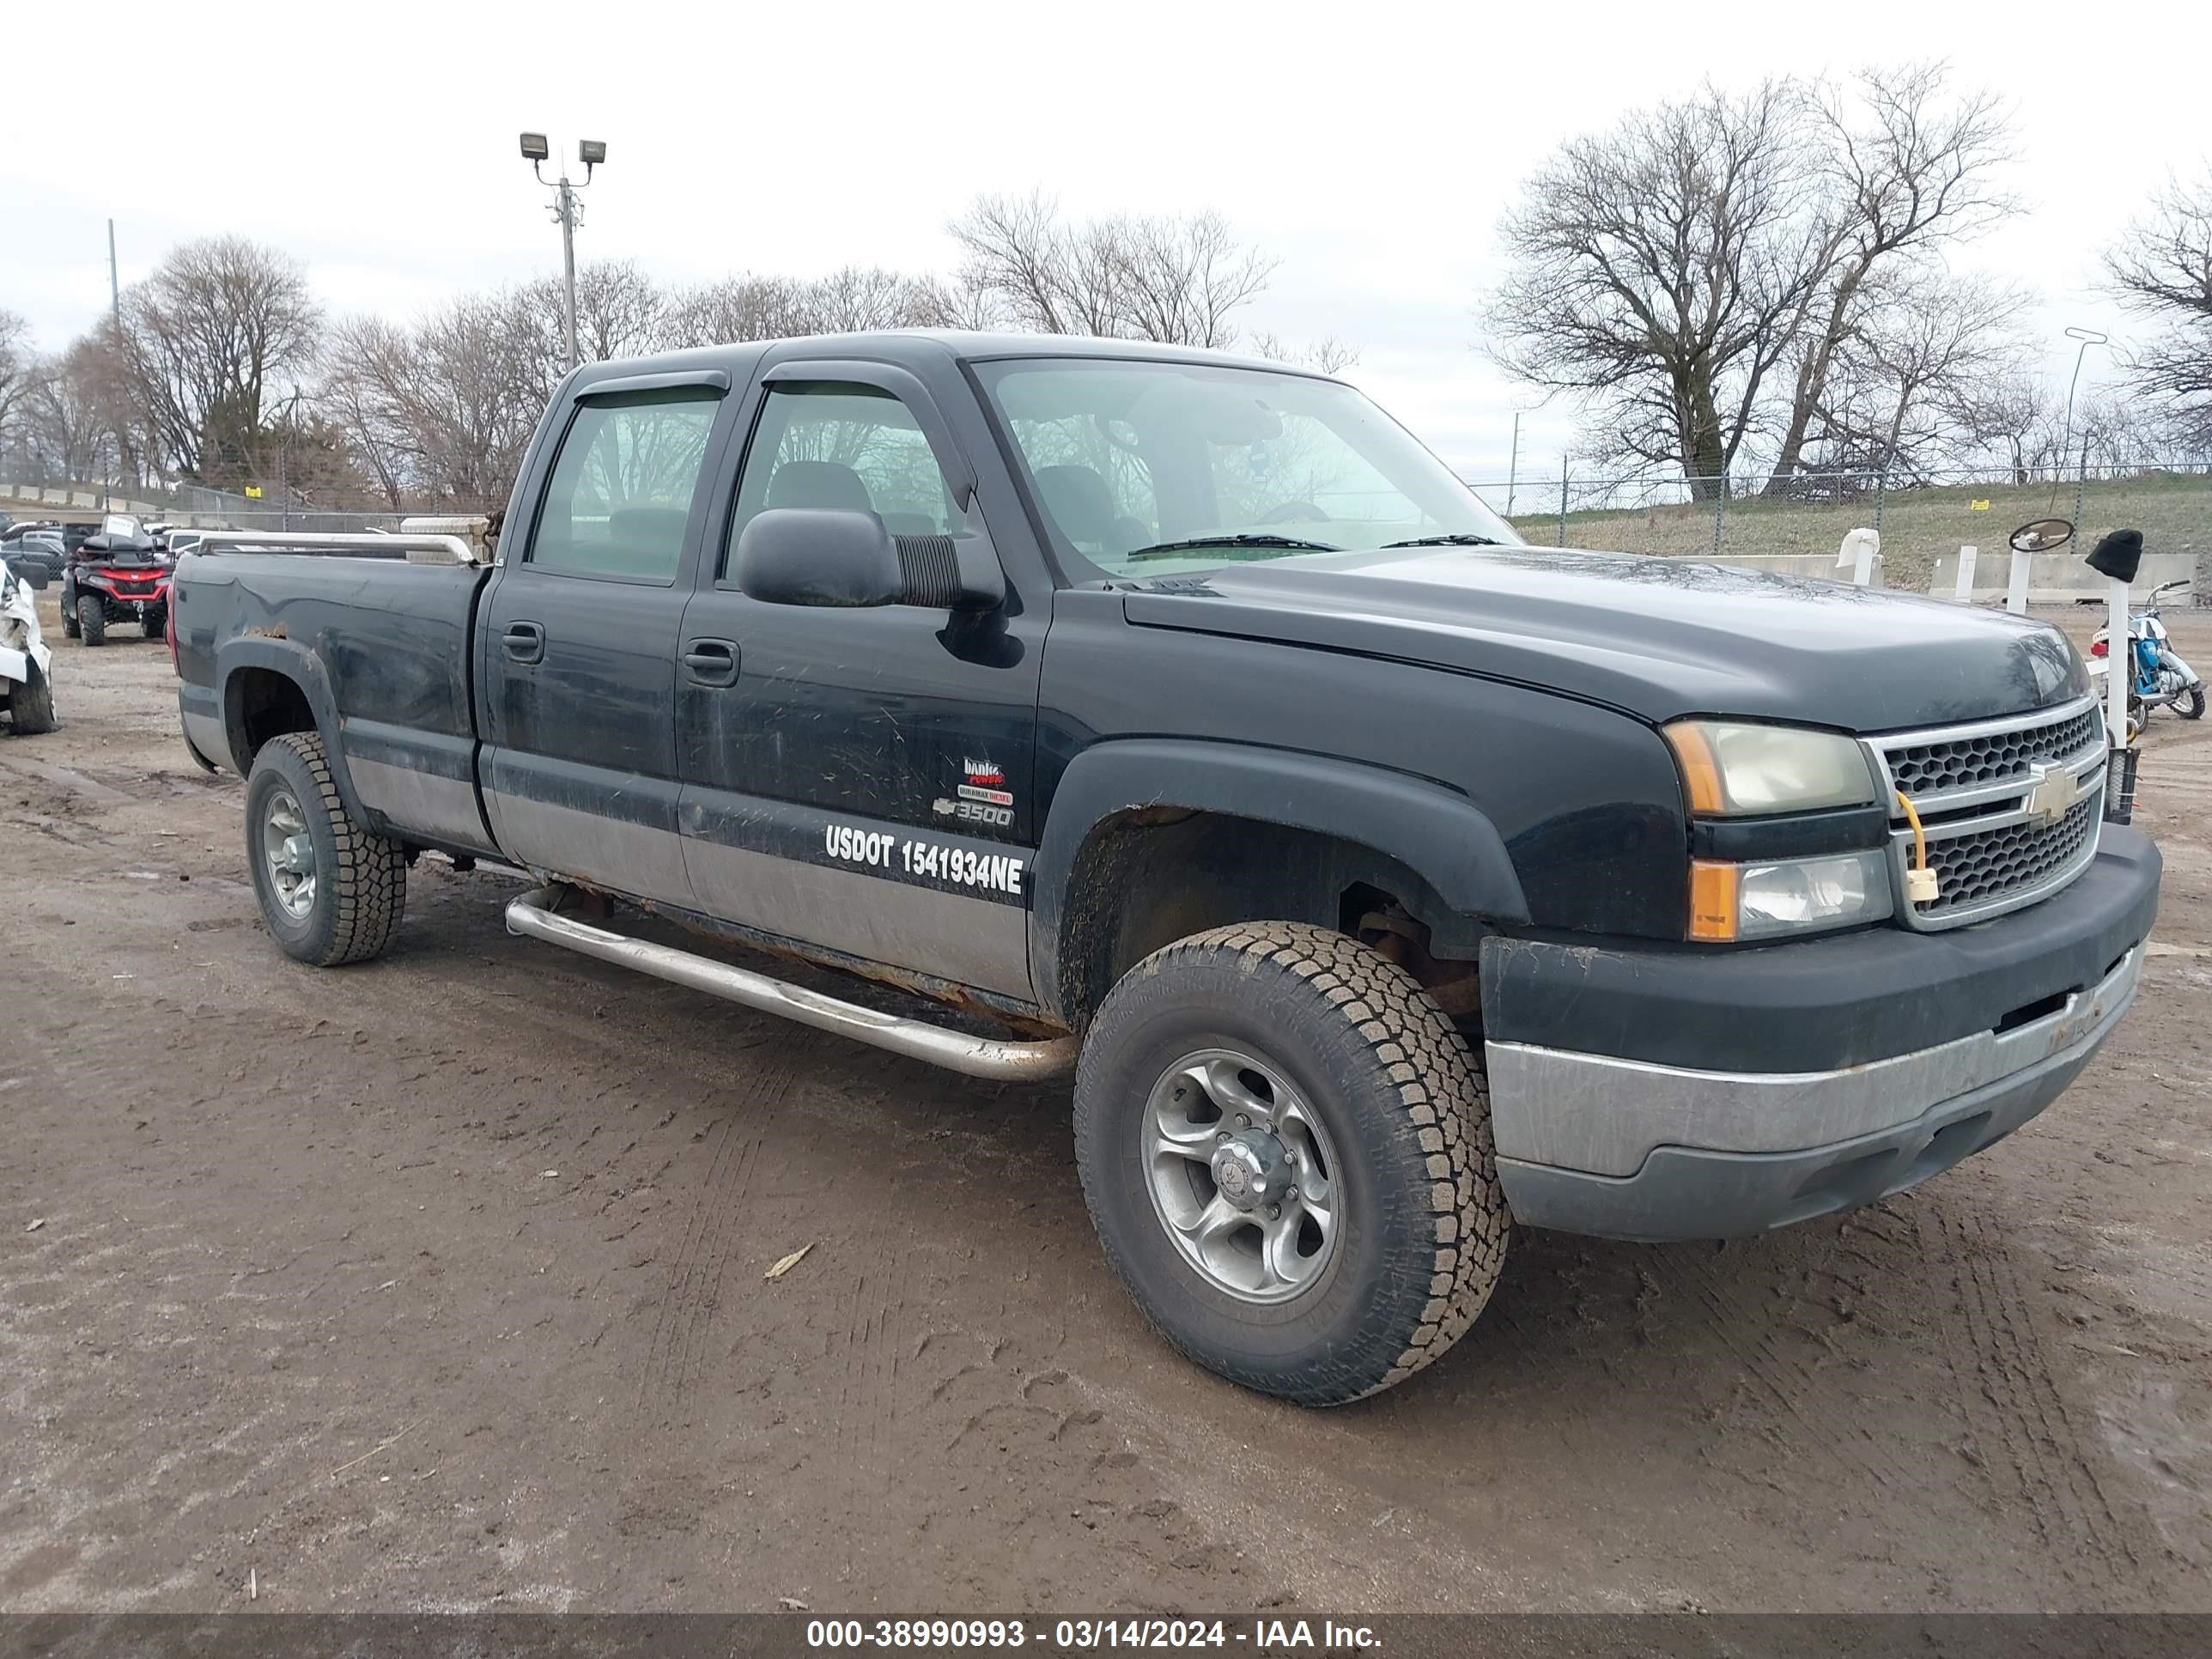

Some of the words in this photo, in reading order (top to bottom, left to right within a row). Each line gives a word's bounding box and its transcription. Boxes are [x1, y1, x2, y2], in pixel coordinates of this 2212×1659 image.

[959, 787, 988, 799] DURAMAX
[989, 792, 1011, 803] DIESEL
[957, 801, 1012, 825] 3500
[825, 824, 894, 867] USDOT
[902, 840, 1024, 895] 1541934NE
